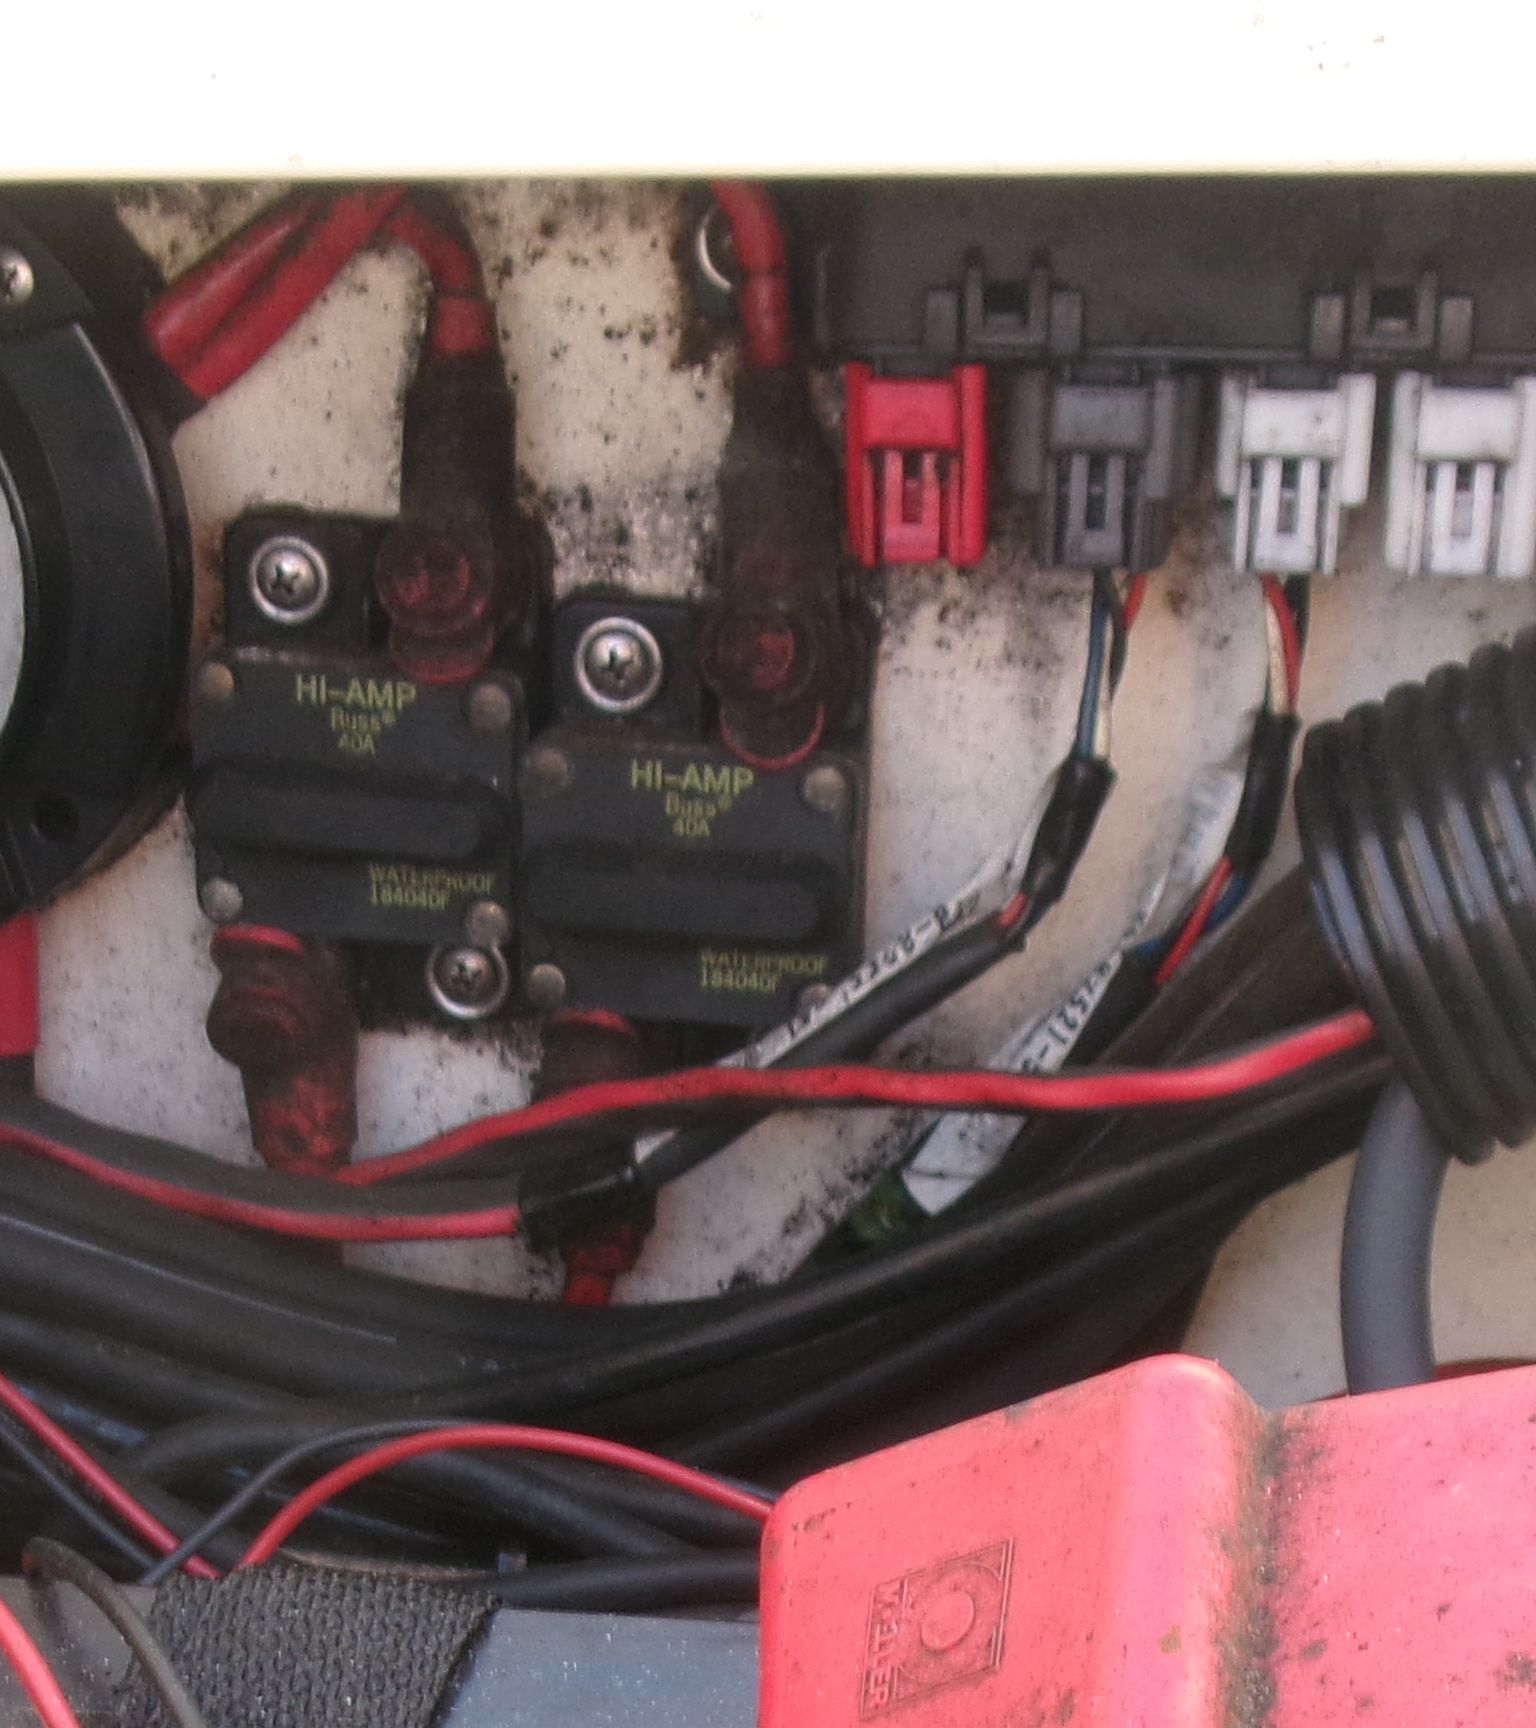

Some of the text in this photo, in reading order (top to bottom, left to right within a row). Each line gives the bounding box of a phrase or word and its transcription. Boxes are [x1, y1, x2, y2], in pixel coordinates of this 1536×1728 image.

[295, 674, 417, 712] HI-AMP
[630, 758, 755, 795] HI-AMP
[367, 863, 496, 894] WATERPROOF
[700, 949, 829, 976] WATERPROOF
